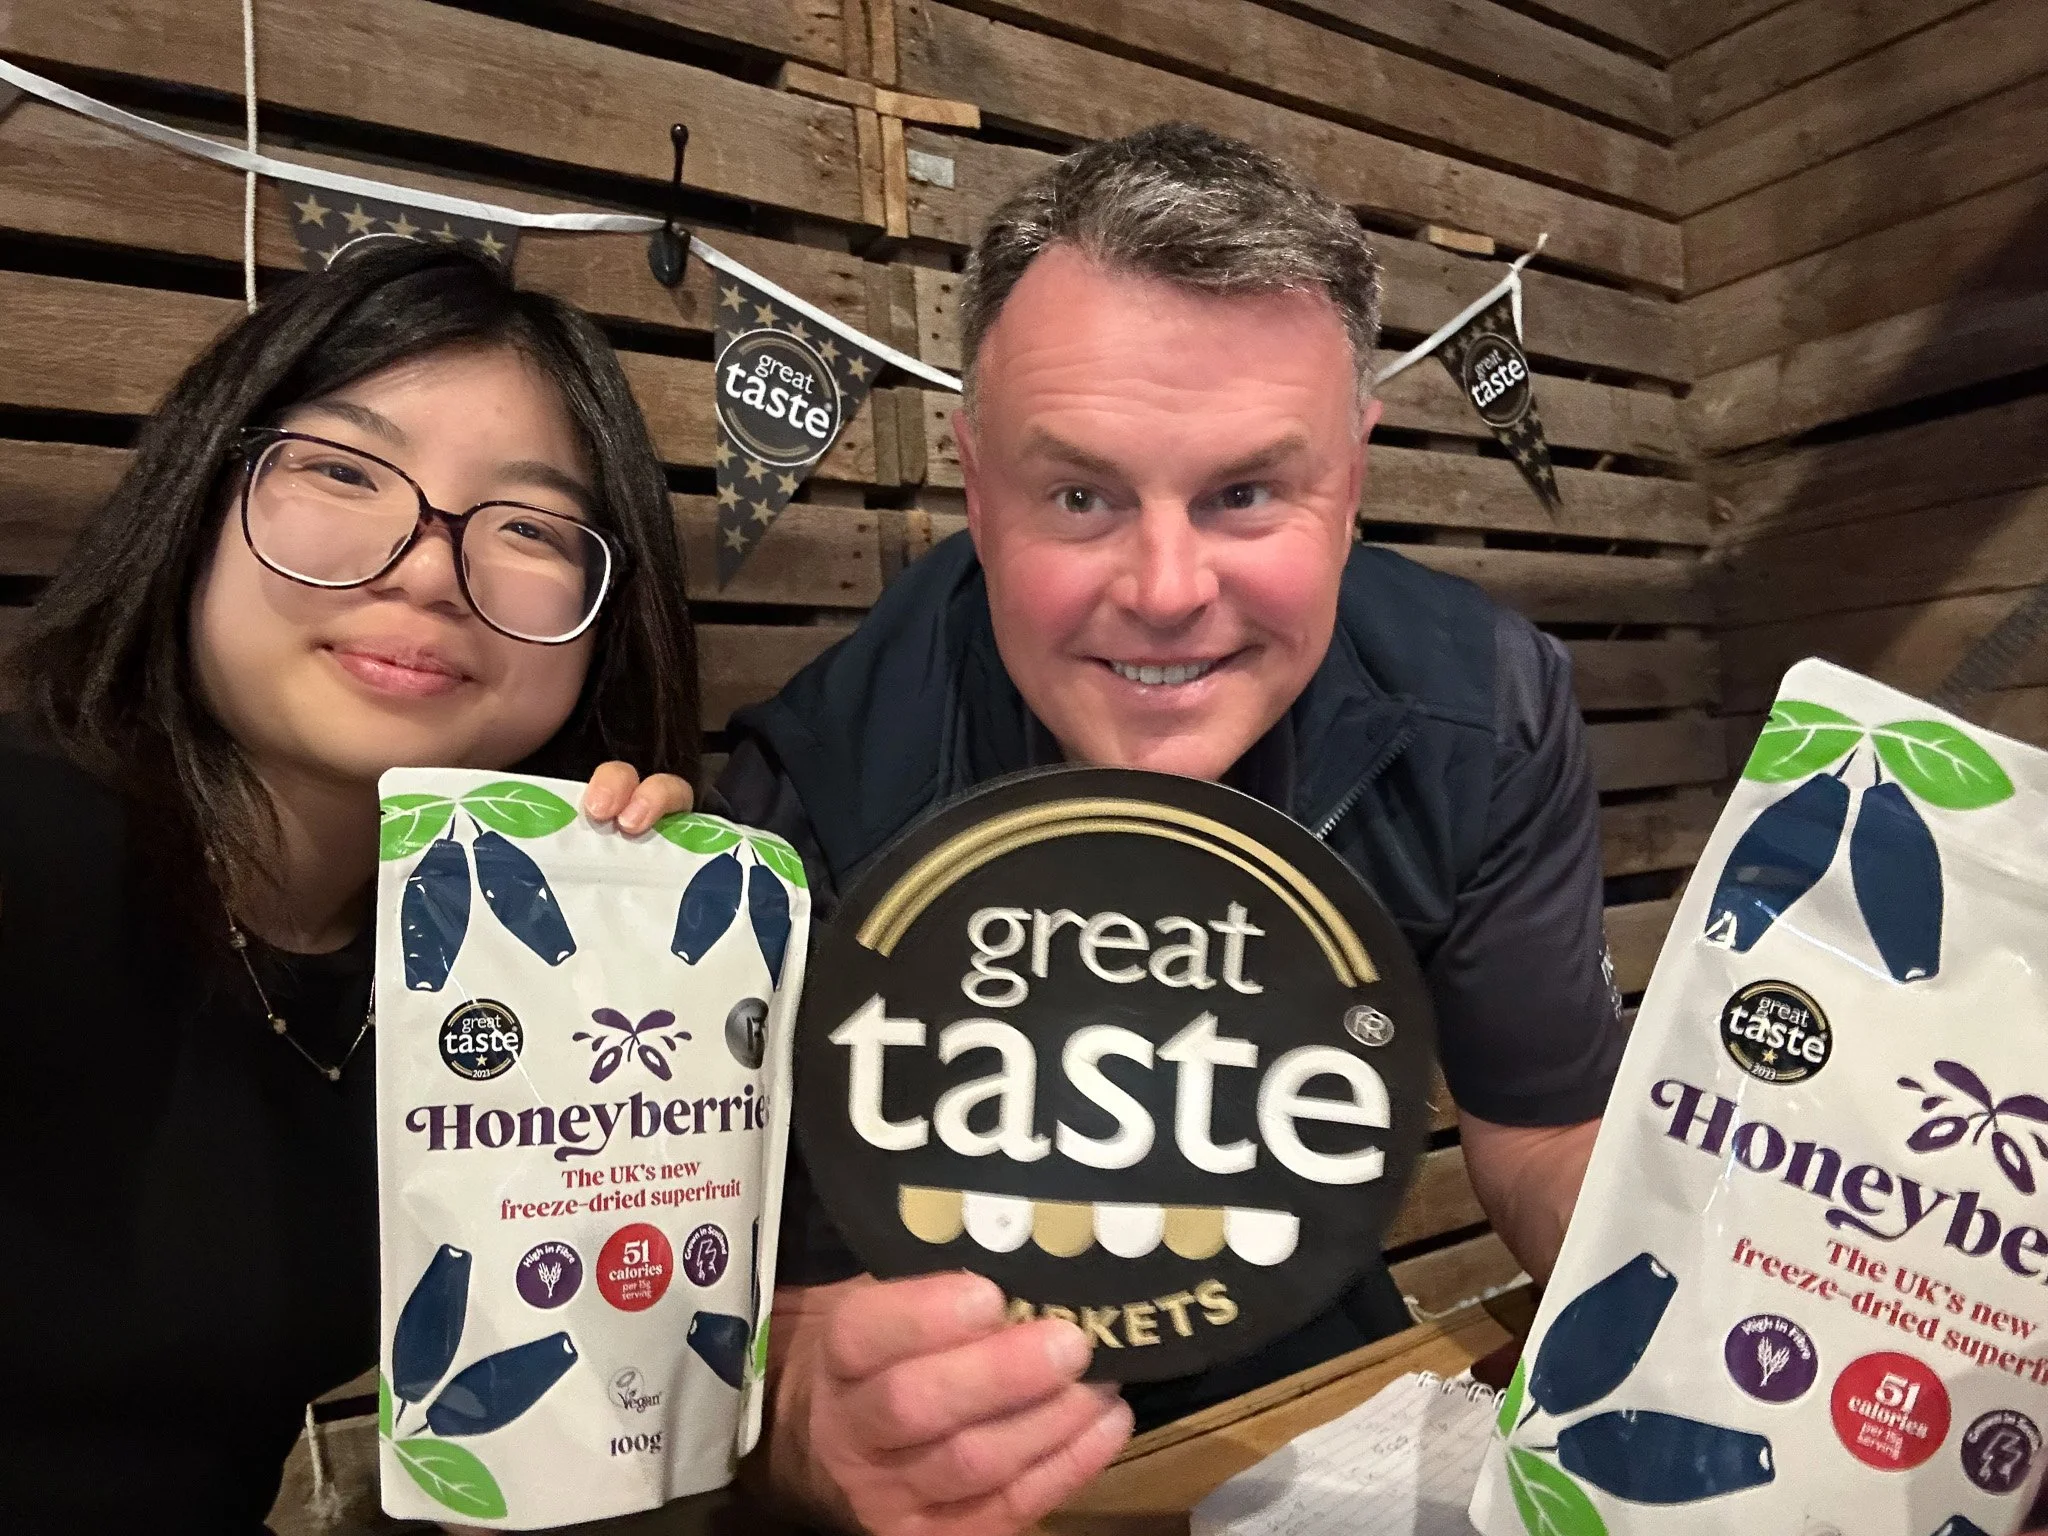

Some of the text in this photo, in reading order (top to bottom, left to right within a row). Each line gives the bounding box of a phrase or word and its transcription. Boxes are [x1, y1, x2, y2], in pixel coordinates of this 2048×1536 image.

[755, 354, 815, 395] great
[1471, 359, 1526, 407] taste
[726, 363, 831, 438] taste
[961, 900, 1266, 1008] great
[462, 1014, 502, 1033] great
[1756, 996, 1810, 1028] great
[444, 1030, 519, 1054] taste
[1729, 1005, 1826, 1063] taste
[828, 993, 1392, 1185] taste
[561, 1161, 701, 1189] The UK's new
[1651, 1079, 2048, 1277] Honeybe
[500, 1179, 741, 1220] freeze-dried superfruit
[523, 1245, 576, 1267] High in Fibre
[608, 1263, 663, 1281] calories
[623, 1239, 650, 1265] 51
[622, 1282, 637, 1293] per
[1731, 1236, 1941, 1342] freeze-dried
[1826, 1238, 2039, 1340] The UK's new
[1774, 1318, 1789, 1333] in
[618, 1391, 661, 1413] Vegan
[1875, 1371, 1921, 1415] 51
[1848, 1395, 1928, 1439] calories
[610, 1431, 663, 1457] 100g
